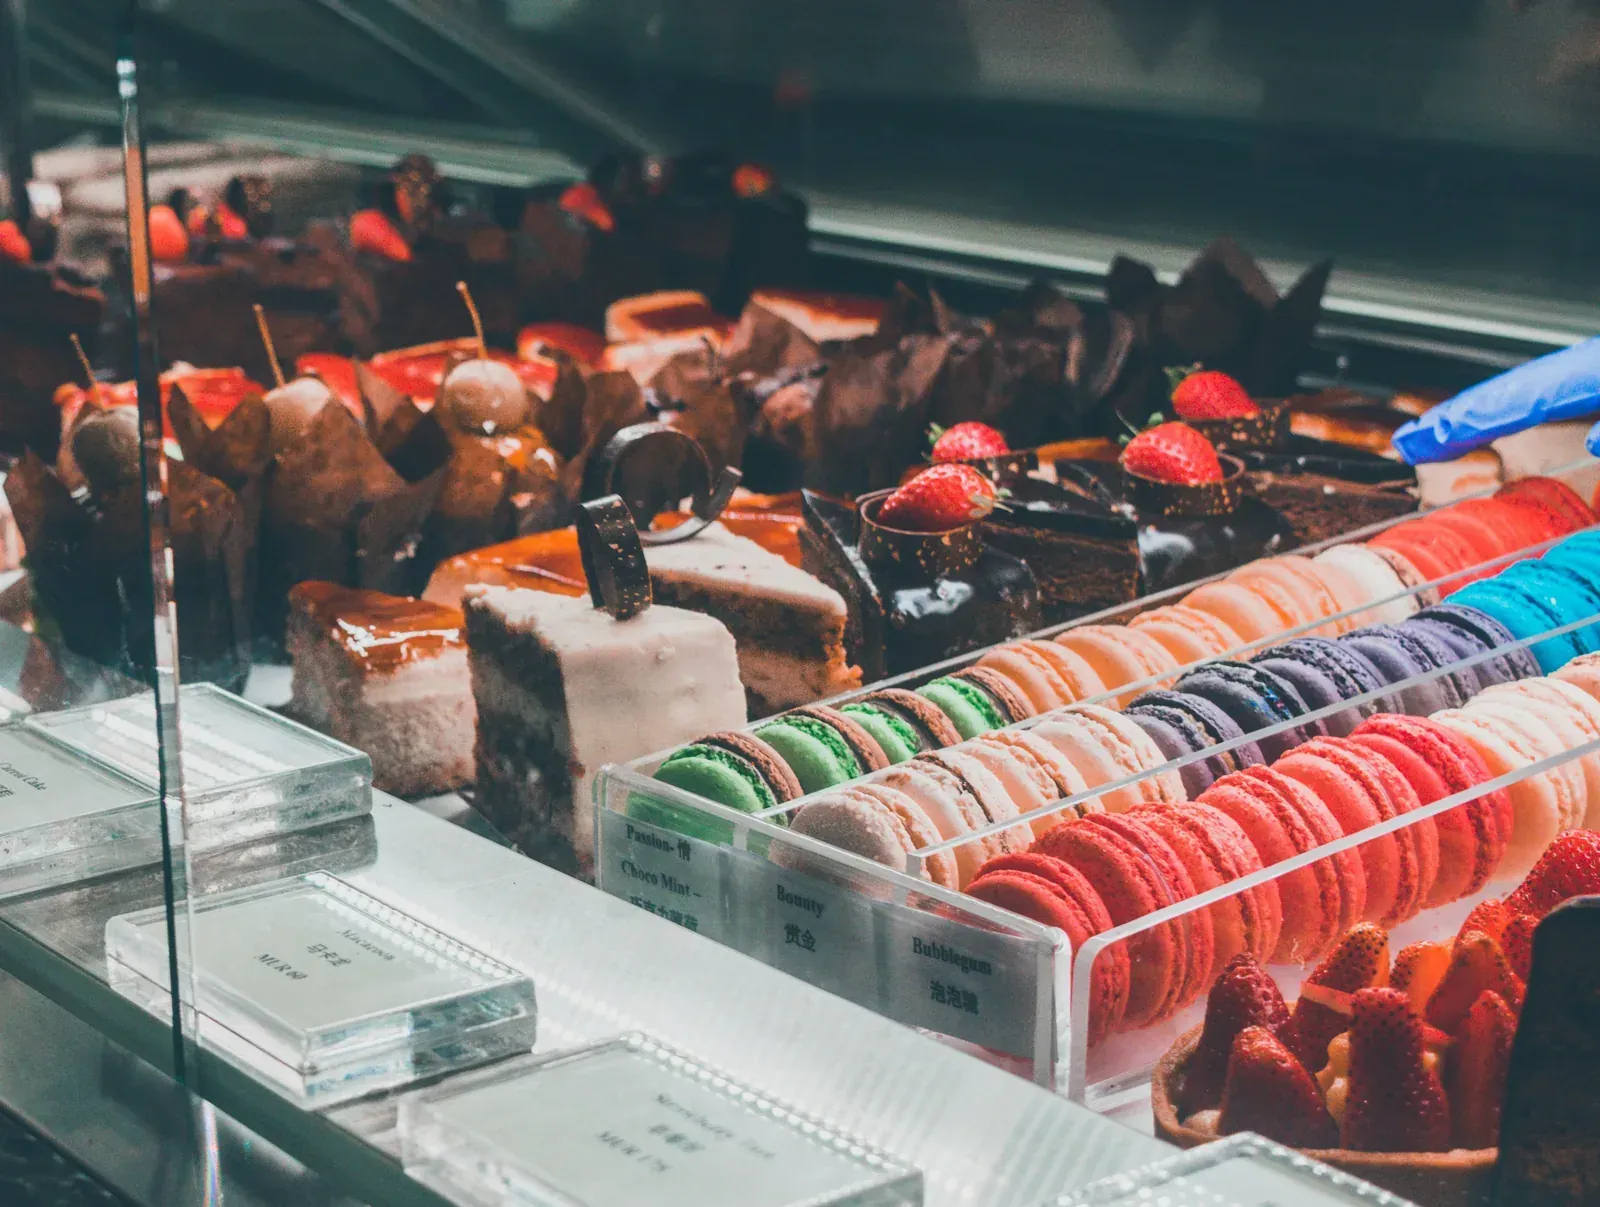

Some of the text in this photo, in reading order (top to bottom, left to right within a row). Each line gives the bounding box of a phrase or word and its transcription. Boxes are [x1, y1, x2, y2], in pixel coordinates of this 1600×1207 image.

[23, 777, 47, 790] Cake
[621, 860, 658, 886] Choco
[660, 872, 690, 898] Mint
[776, 884, 824, 918] Bounty
[784, 922, 816, 952] 赏金
[912, 936, 992, 975] Bubblegum
